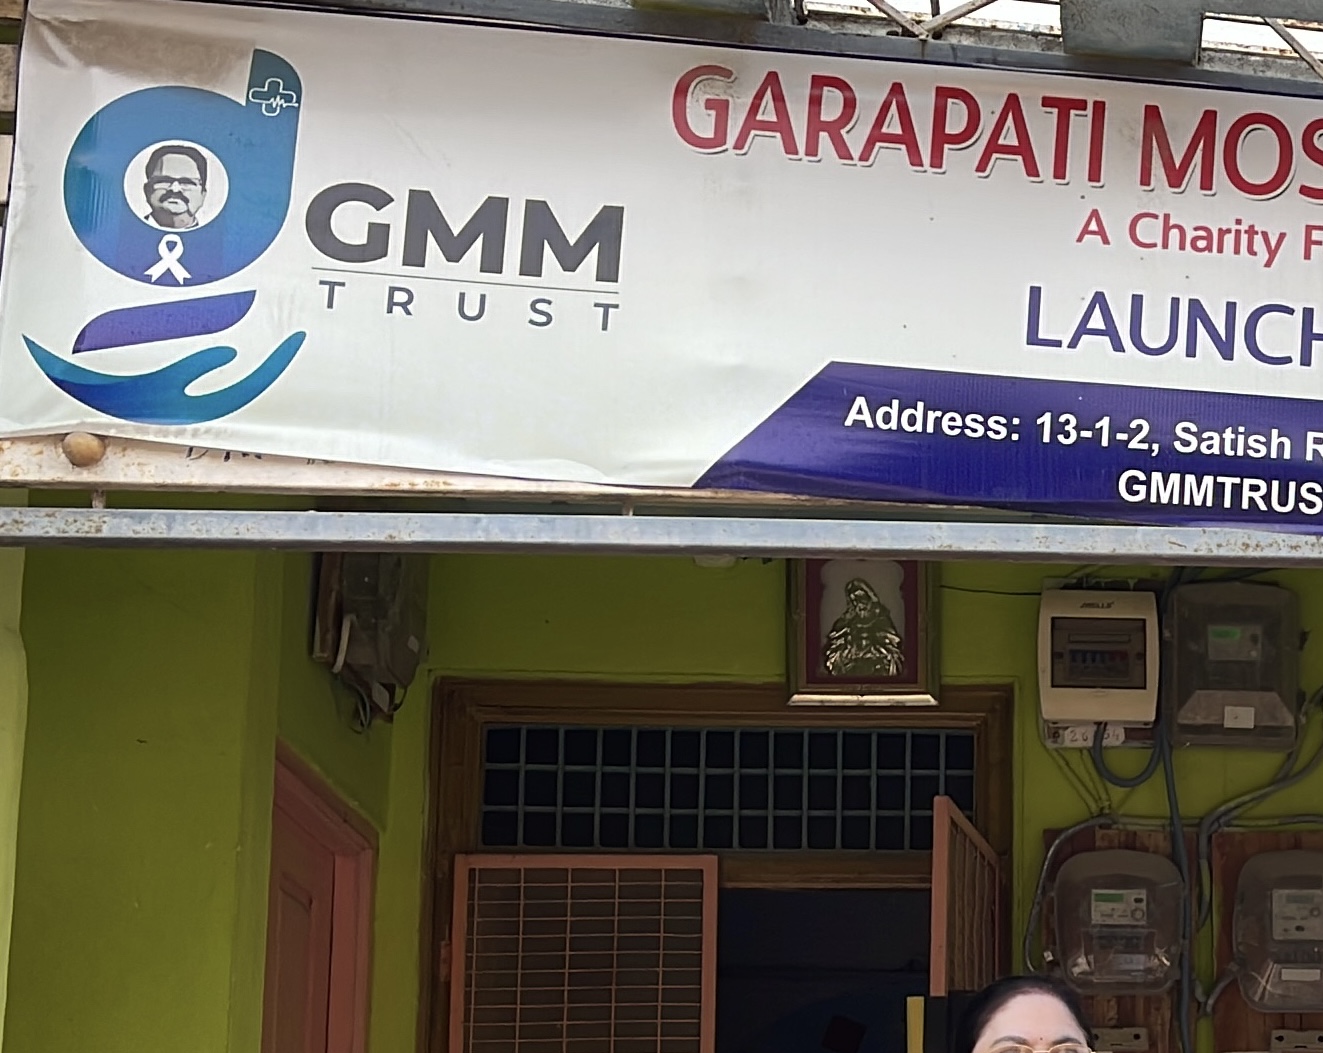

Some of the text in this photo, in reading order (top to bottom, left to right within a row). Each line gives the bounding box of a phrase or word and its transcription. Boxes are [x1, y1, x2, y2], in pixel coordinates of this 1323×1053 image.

[671, 62, 1106, 186] GARAPATI
[305, 182, 624, 283] GMM
[1076, 208, 1110, 246] A
[1128, 211, 1286, 268] Charity
[318, 280, 620, 331] TRUST
[844, 396, 1021, 442] Address:
[1035, 412, 1160, 455] 13-1-2,
[1173, 421, 1291, 460] Satish
